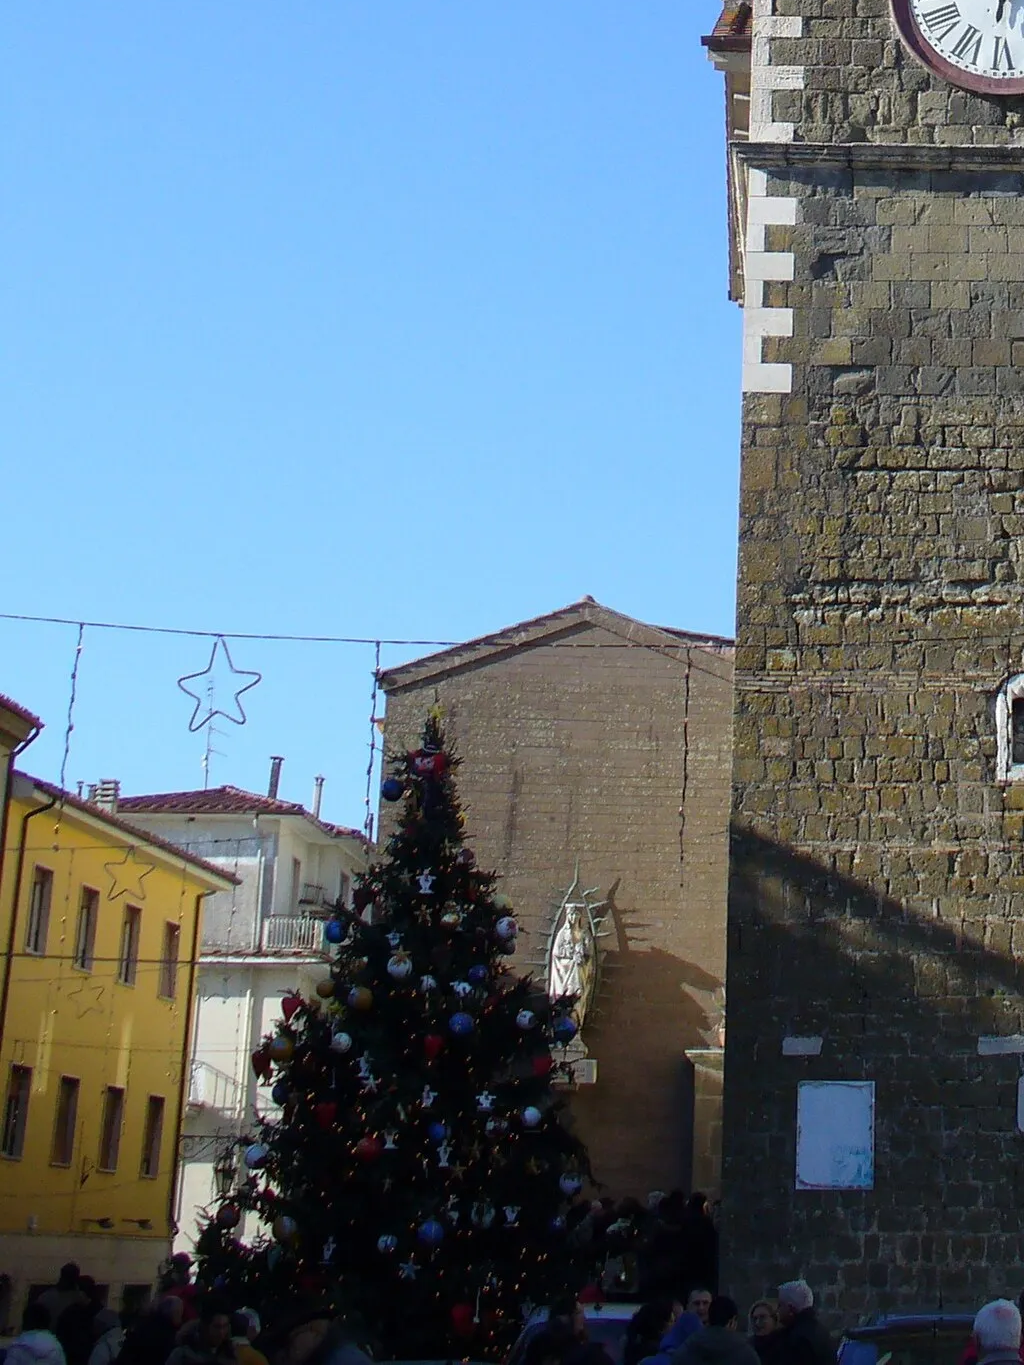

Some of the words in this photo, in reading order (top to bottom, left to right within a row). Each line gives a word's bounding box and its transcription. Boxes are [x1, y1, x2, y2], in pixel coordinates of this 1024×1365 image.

[922, 2, 960, 44] VIII
[950, 24, 984, 66] VII
[991, 36, 1015, 70] VI
